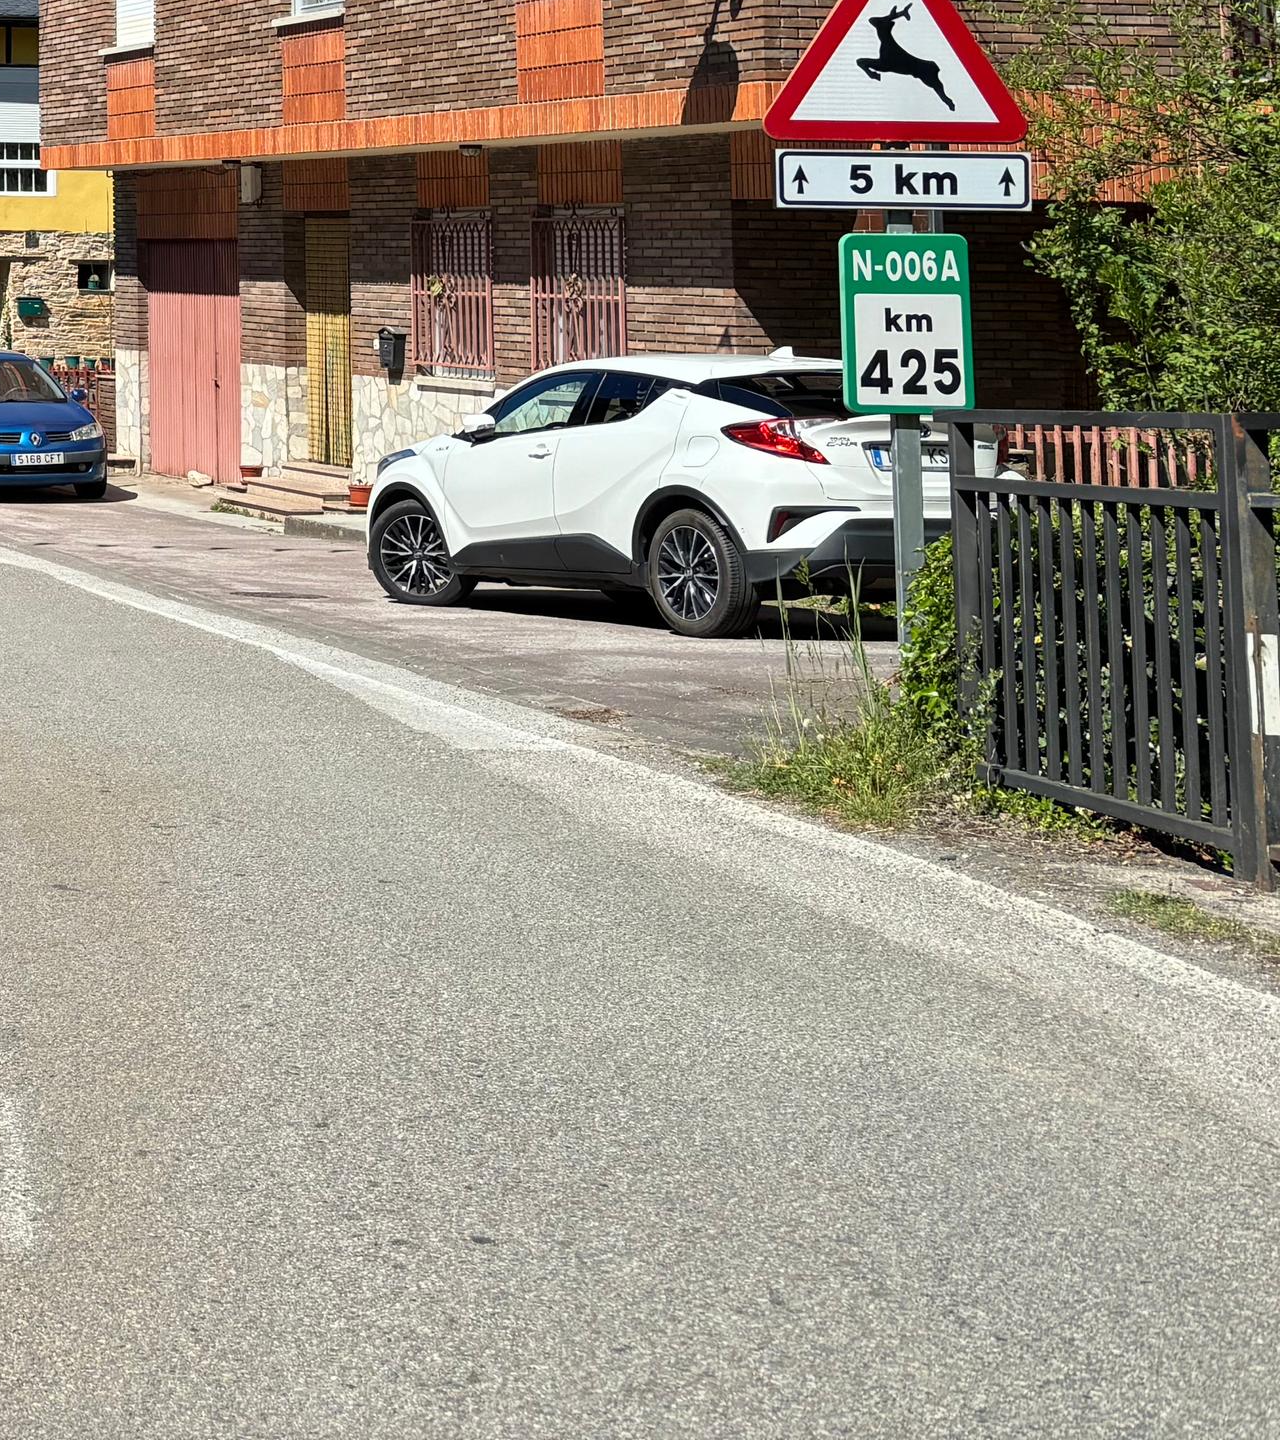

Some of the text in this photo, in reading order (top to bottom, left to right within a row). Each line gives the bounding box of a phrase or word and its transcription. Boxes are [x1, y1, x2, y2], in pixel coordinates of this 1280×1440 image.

[849, 163, 958, 196] 5 km
[852, 249, 960, 282] N-006A
[884, 307, 934, 333] km
[860, 348, 962, 395] 425
[17, 453, 62, 464] 5168 CFT
